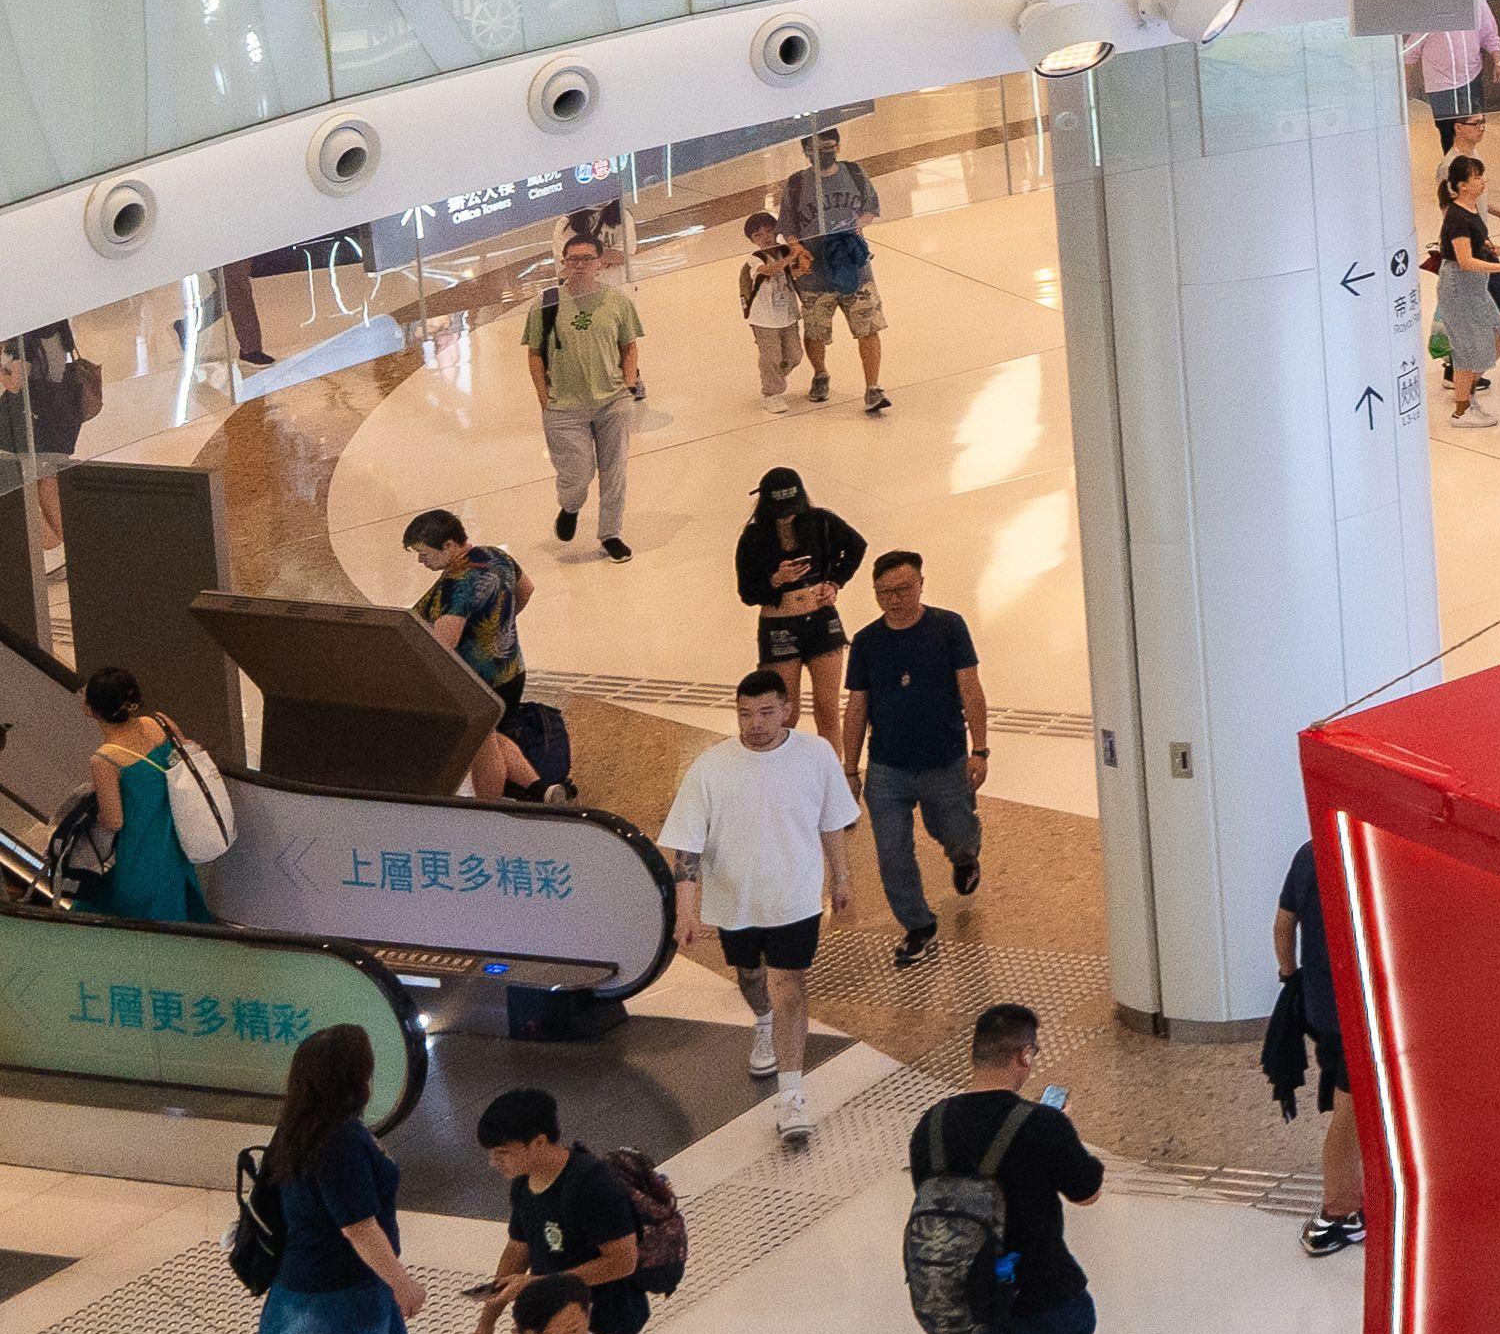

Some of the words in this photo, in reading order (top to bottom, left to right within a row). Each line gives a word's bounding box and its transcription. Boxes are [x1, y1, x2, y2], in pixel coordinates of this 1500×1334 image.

[453, 204, 483, 224] Office
[484, 197, 514, 218] Towers
[528, 180, 563, 201] Cinema
[342, 847, 574, 902] 上層更多精彩
[70, 980, 311, 1045] 上層更多精彩
